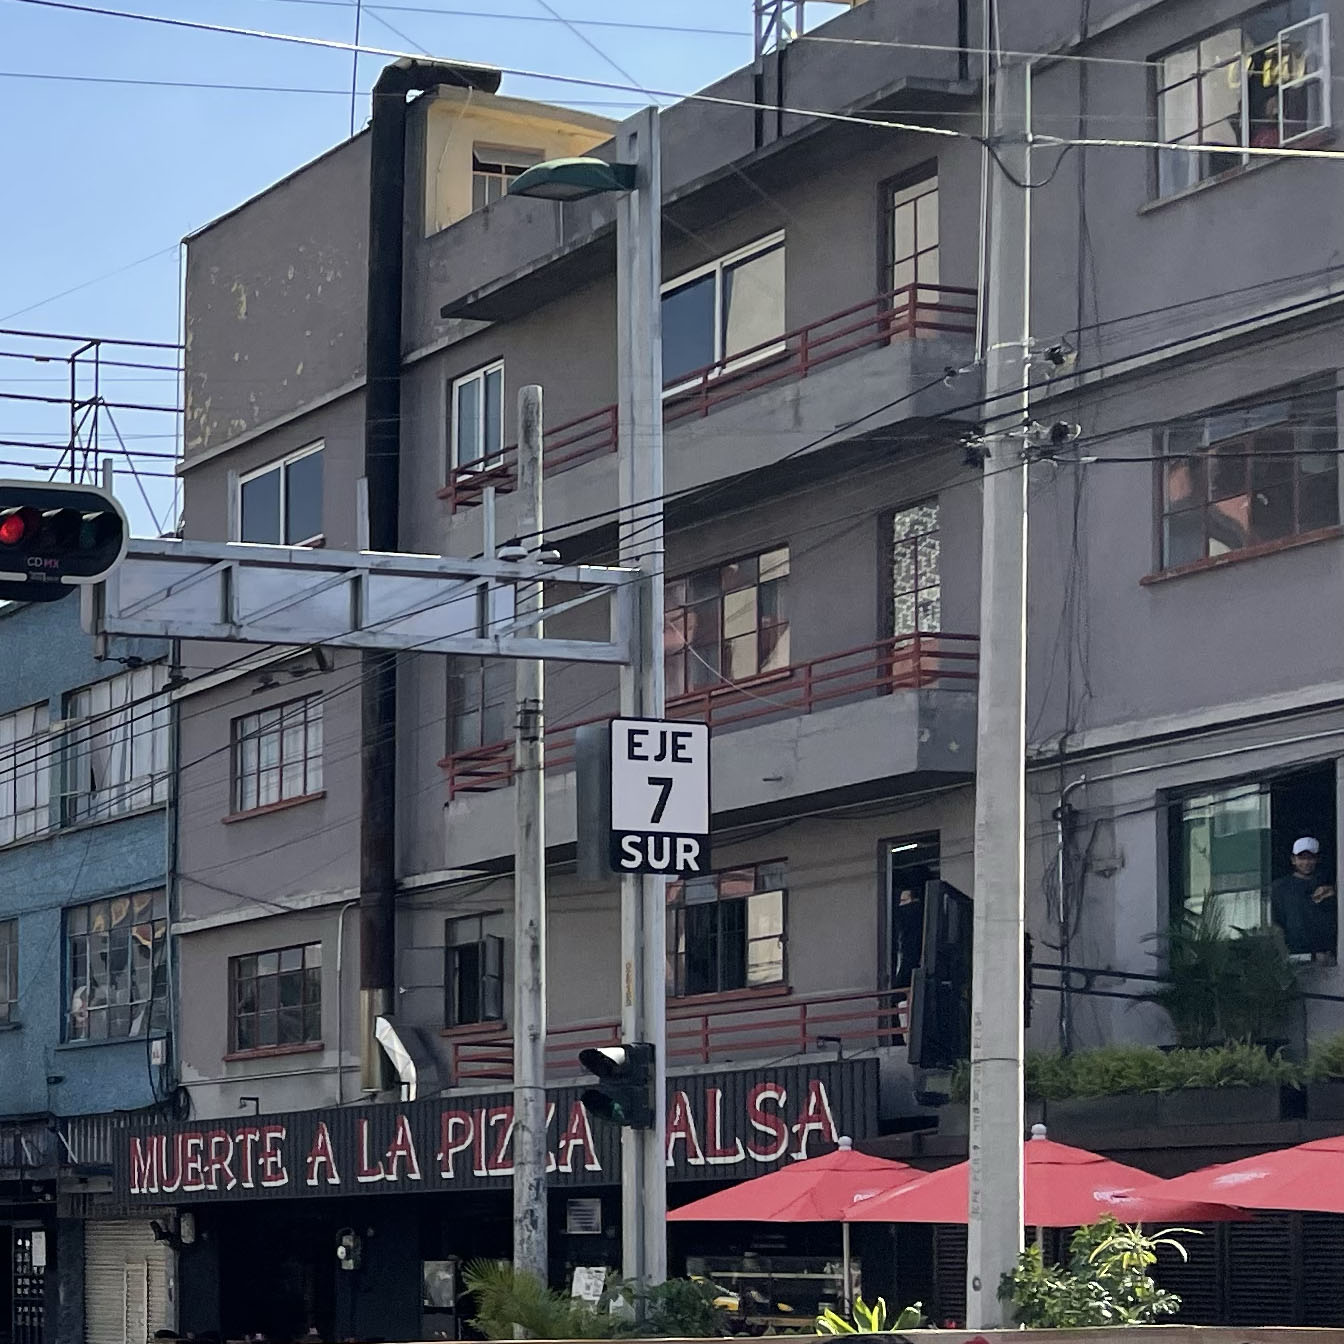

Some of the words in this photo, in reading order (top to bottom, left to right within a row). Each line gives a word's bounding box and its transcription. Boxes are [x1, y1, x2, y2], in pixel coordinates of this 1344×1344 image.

[27, 556, 59, 568] CDMX
[627, 728, 693, 764] EJE
[647, 776, 673, 824] 7
[620, 834, 701, 871] SUR
[130, 1125, 289, 1195] MUERTE
[306, 1120, 341, 1186] A
[356, 1114, 422, 1183] LA
[664, 1079, 840, 1167] ALSA
